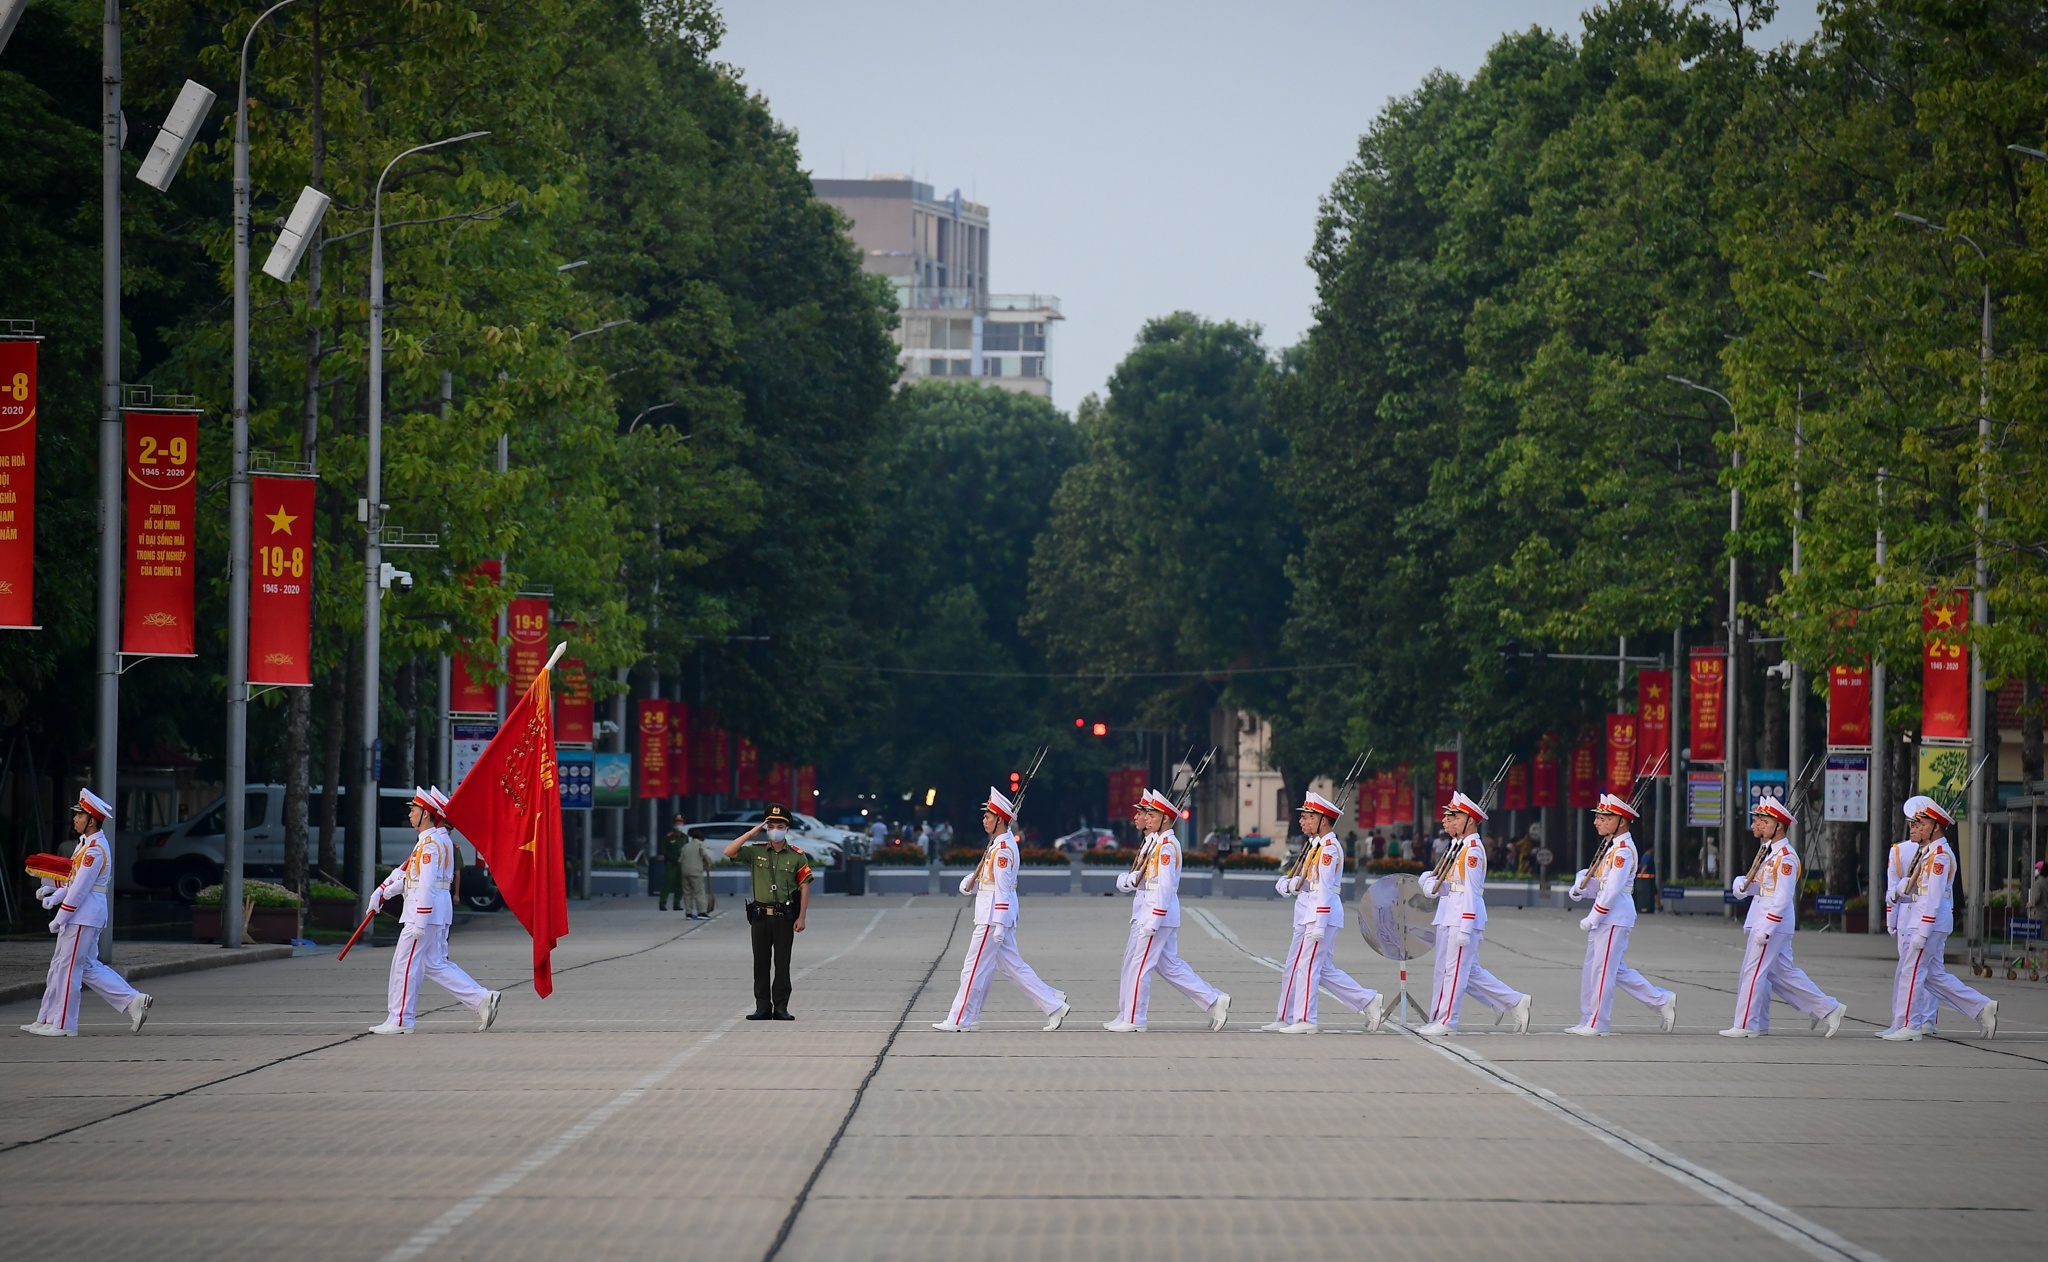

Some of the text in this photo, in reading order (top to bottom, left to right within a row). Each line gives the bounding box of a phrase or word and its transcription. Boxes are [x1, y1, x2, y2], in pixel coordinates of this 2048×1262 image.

[1, 406, 24, 415] 2020
[139, 436, 187, 465] 2-9
[141, 468, 160, 476] 1945
[149, 500, 176, 517] CHỦ TỊCH
[165, 520, 181, 530] MINH
[136, 550, 156, 561] TRONG
[260, 546, 304, 577] 19-8
[174, 566, 182, 577] TA
[262, 583, 278, 593] 1945
[283, 585, 300, 595] 2020
[515, 614, 544, 630] 19-8
[1695, 660, 1719, 673] 19-8
[644, 711, 664, 724] 2-9
[1643, 704, 1665, 721] 2-9
